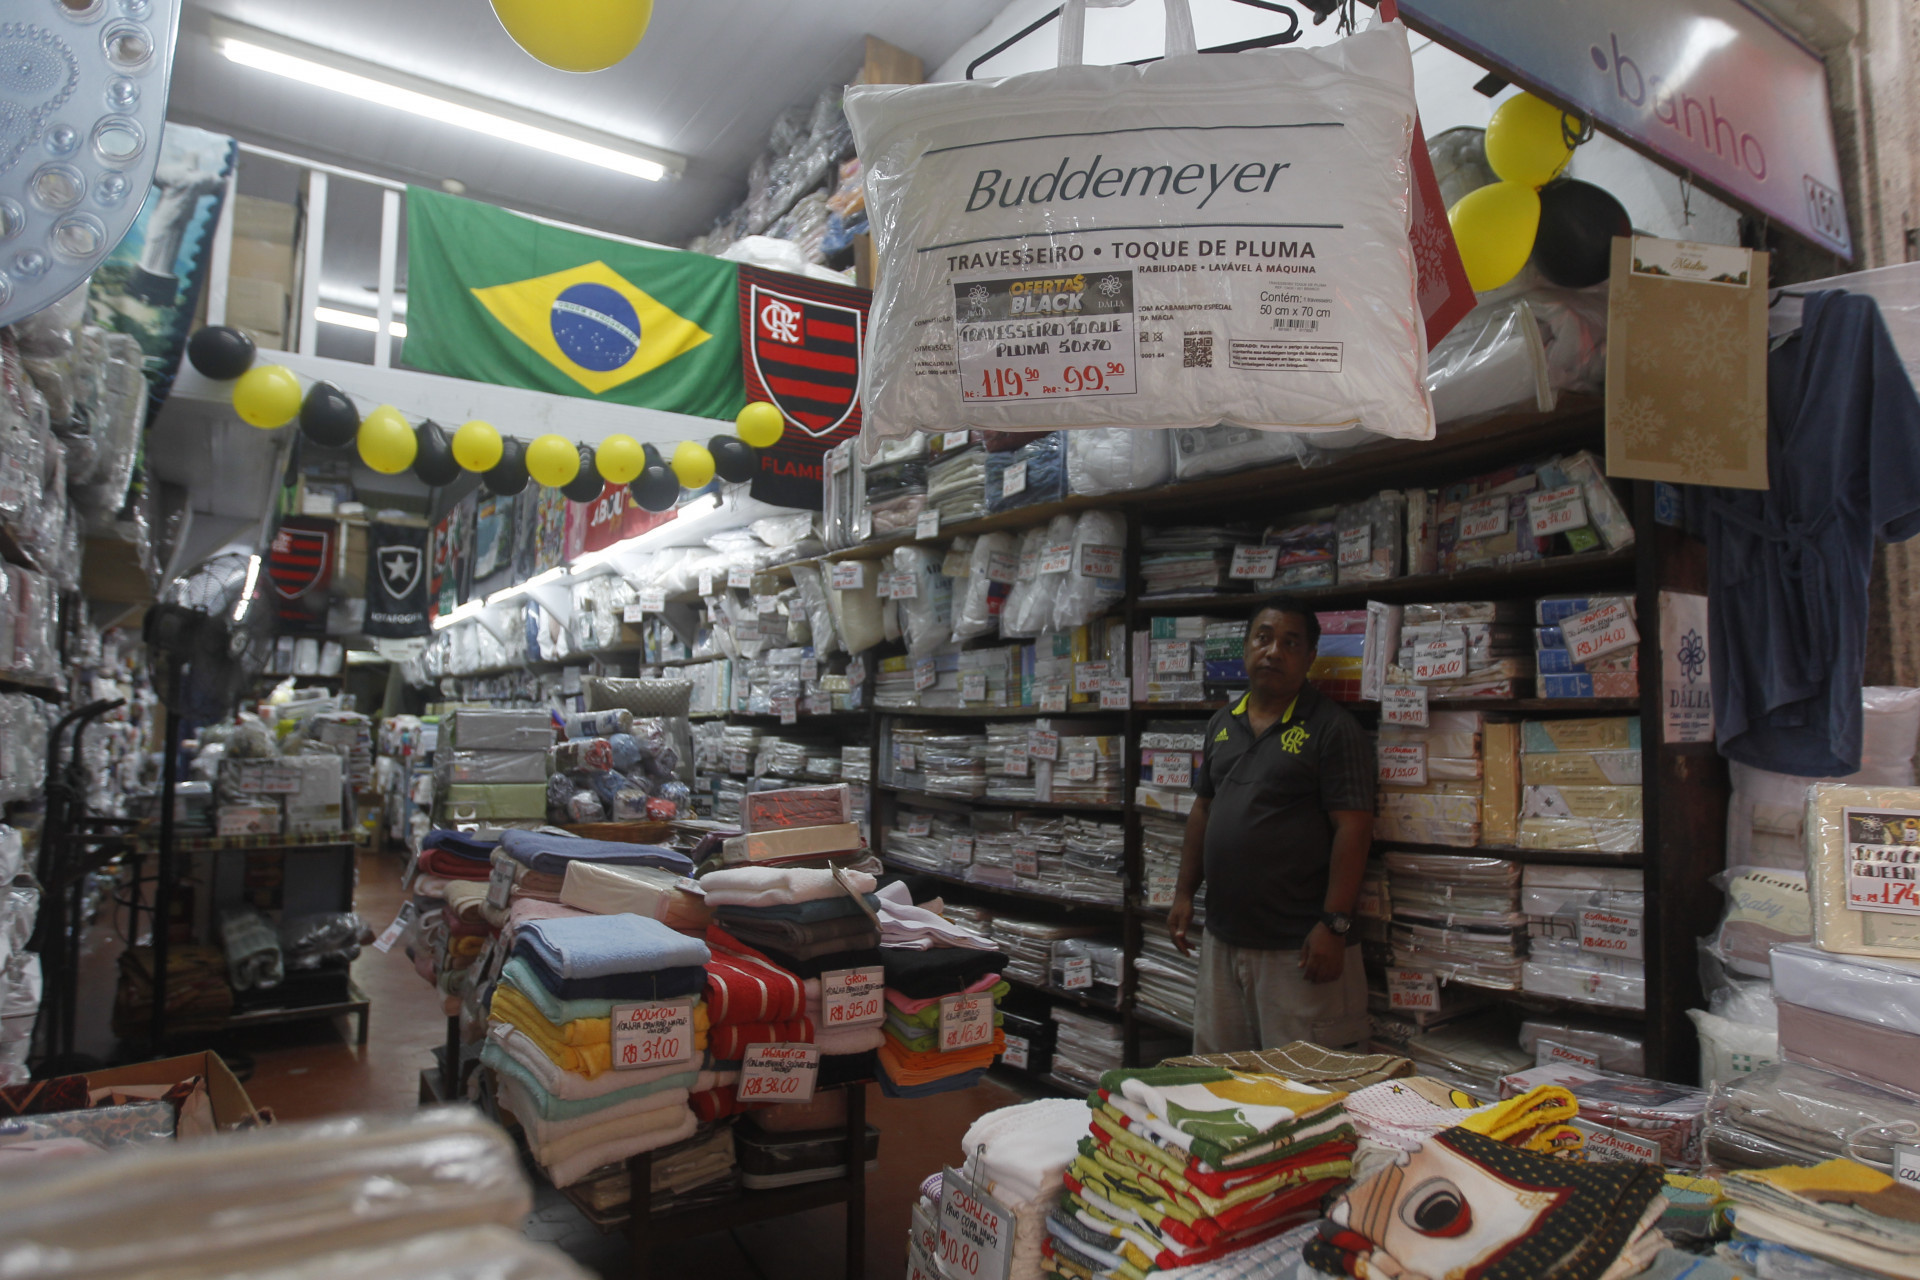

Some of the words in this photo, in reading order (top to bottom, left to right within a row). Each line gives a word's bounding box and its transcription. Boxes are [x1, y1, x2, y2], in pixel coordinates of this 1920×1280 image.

[965, 154, 1291, 213] Buddemeyer
[947, 244, 1084, 272] TRAVESSEIRO
[1112, 241, 1189, 261] TOQUE
[1199, 240, 1226, 257] DE
[1235, 240, 1316, 259] PLUMA
[1138, 263, 1197, 274] RABILIDADE
[1208, 262, 1252, 273] LAVÁVEL
[1266, 263, 1317, 274] MÁQUINA
[1010, 292, 1084, 315] BLACK
[1260, 290, 1303, 304] Contém:
[1260, 304, 1272, 315] 50
[1275, 307, 1289, 316] cm
[1292, 308, 1298, 316] x
[1302, 306, 1314, 317] 70
[1316, 308, 1331, 318] cm
[959, 319, 1065, 342] TRAVESSEIRO
[1068, 317, 1122, 334] TOQUE
[996, 341, 1050, 357] PLUMA
[1670, 684, 1711, 709] DÁLIA
[1853, 862, 1916, 880] QUEEN
[1738, 892, 1784, 919] Baby
[631, 1007, 677, 1021] BOUTON
